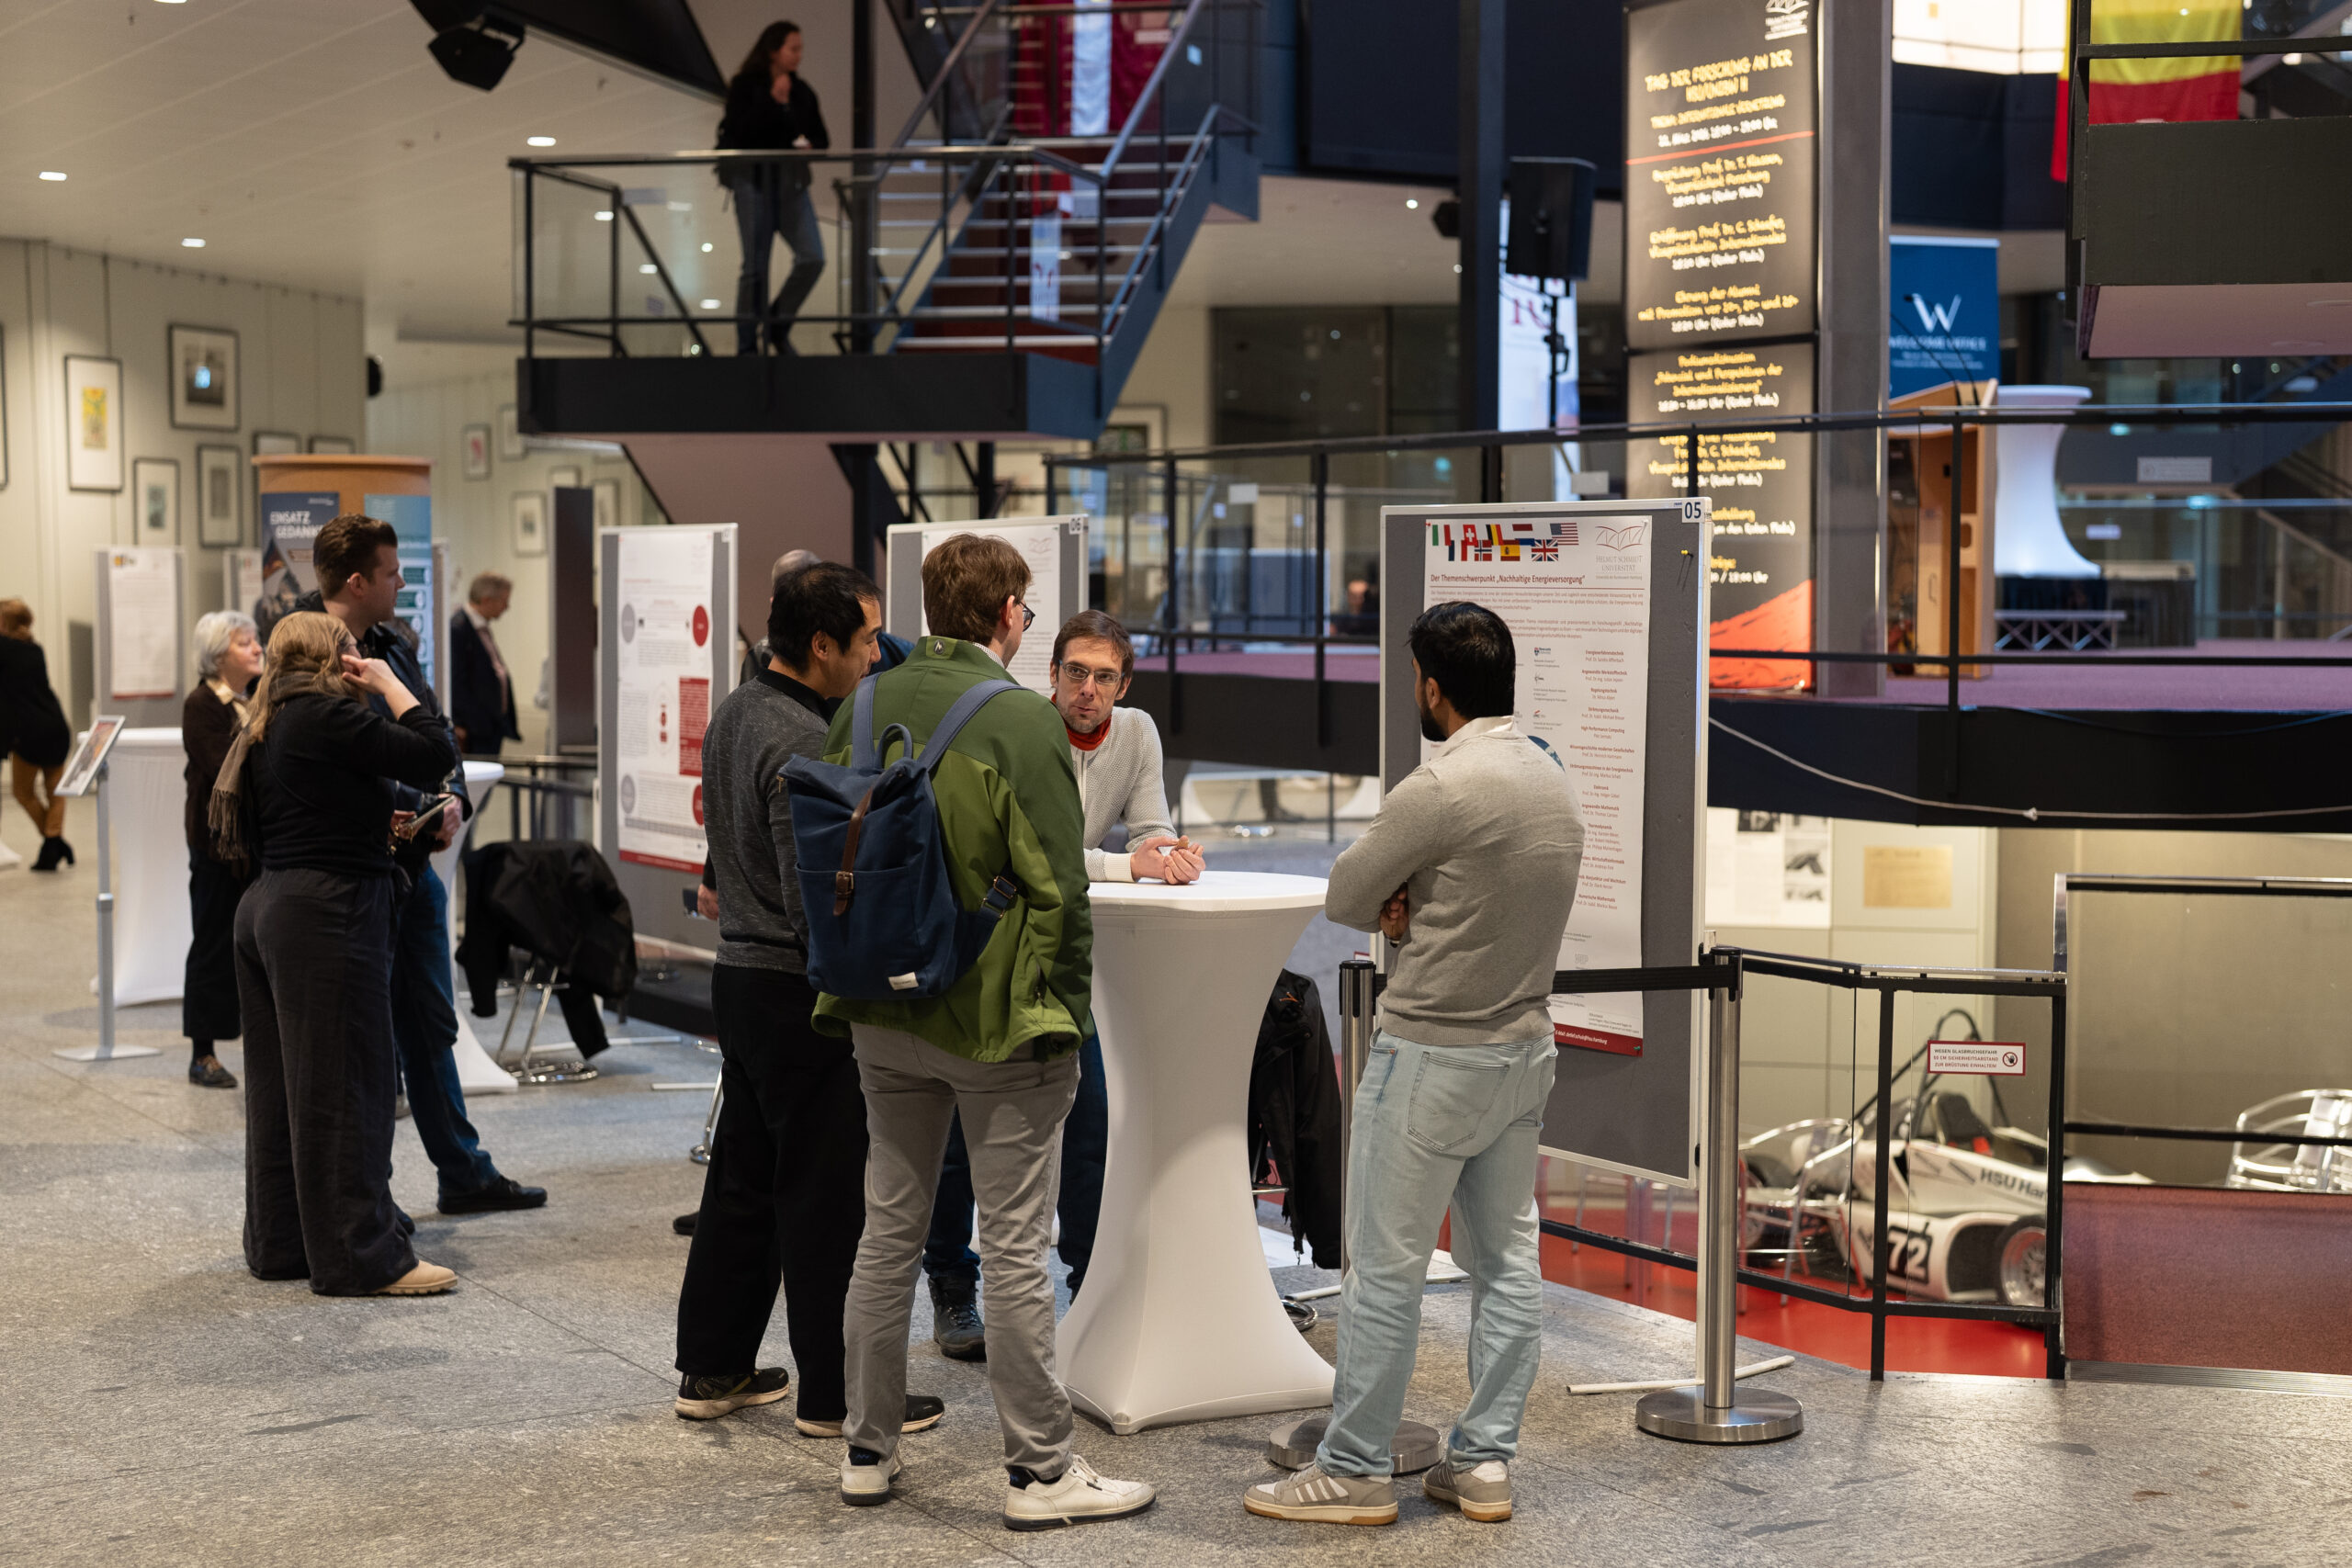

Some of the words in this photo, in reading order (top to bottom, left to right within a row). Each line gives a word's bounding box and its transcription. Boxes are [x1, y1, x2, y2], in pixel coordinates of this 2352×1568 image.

[270, 511, 311, 525] EINSATZ
[1685, 502, 1702, 519] 05
[1070, 517, 1082, 532] 06
[1596, 555, 1617, 563] HELMUT
[1618, 555, 1643, 563] SCHMIDT
[1442, 575, 1496, 583] Themenschwerpunkt
[1496, 575, 1532, 584] „Nachhaltige
[1980, 1168, 2016, 1189] HSU
[1888, 1231, 1928, 1280] 72
